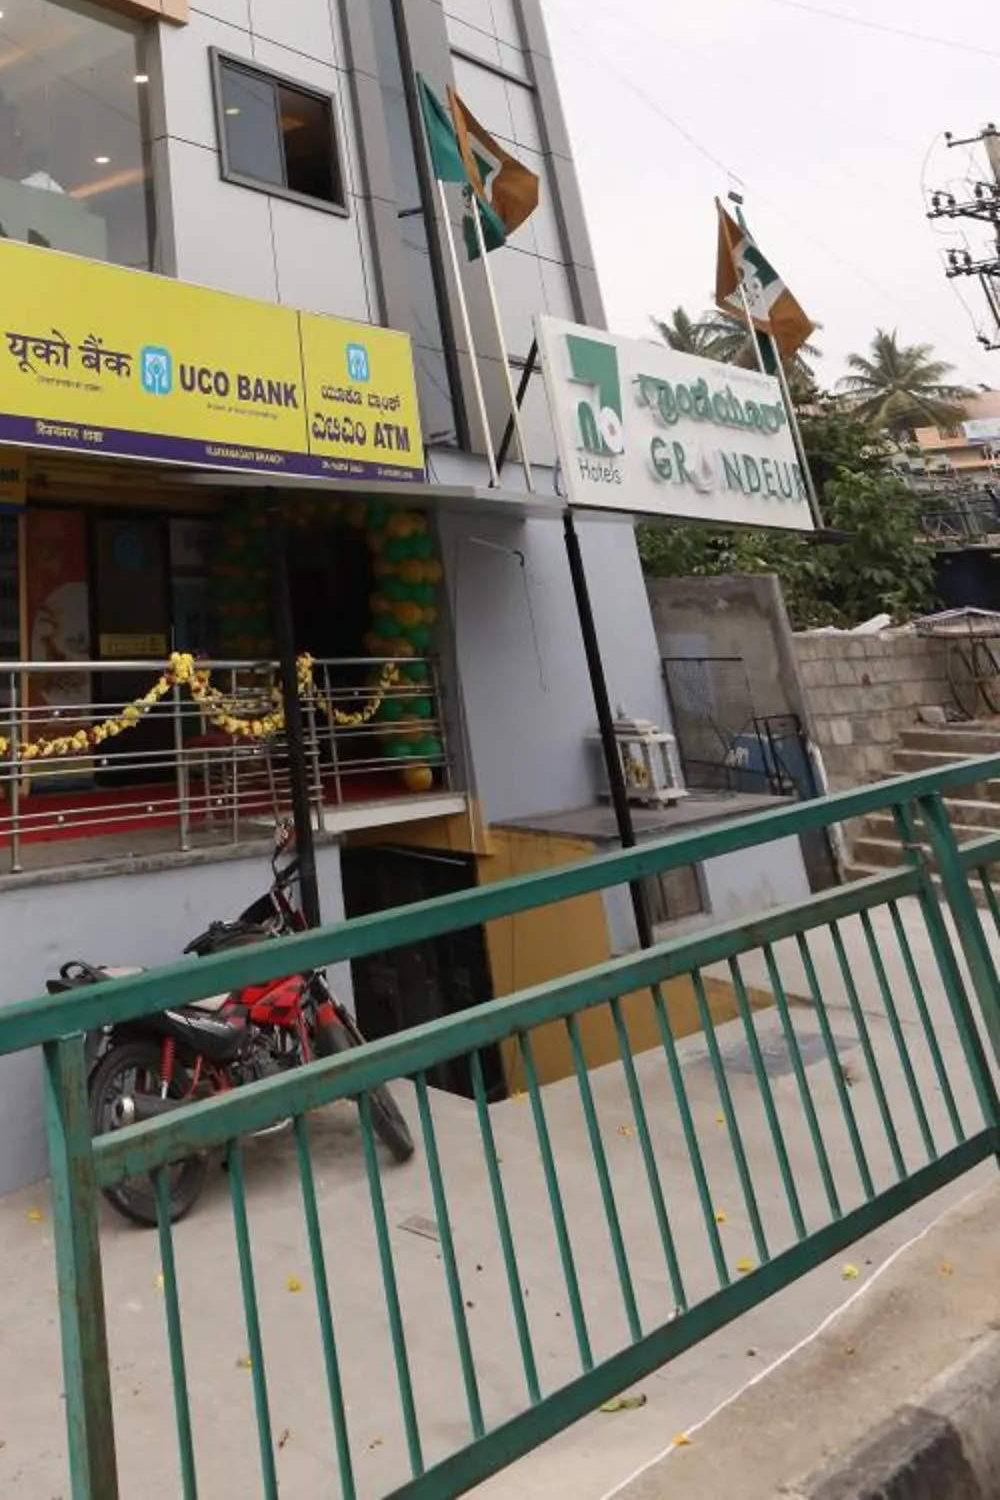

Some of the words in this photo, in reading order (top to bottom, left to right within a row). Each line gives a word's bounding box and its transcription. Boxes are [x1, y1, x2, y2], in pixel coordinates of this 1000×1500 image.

[5, 328, 71, 373] यूको
[78, 333, 132, 378] बैंक
[180, 364, 230, 397] UCO
[237, 373, 299, 409] BANK
[373, 422, 410, 452] ATM
